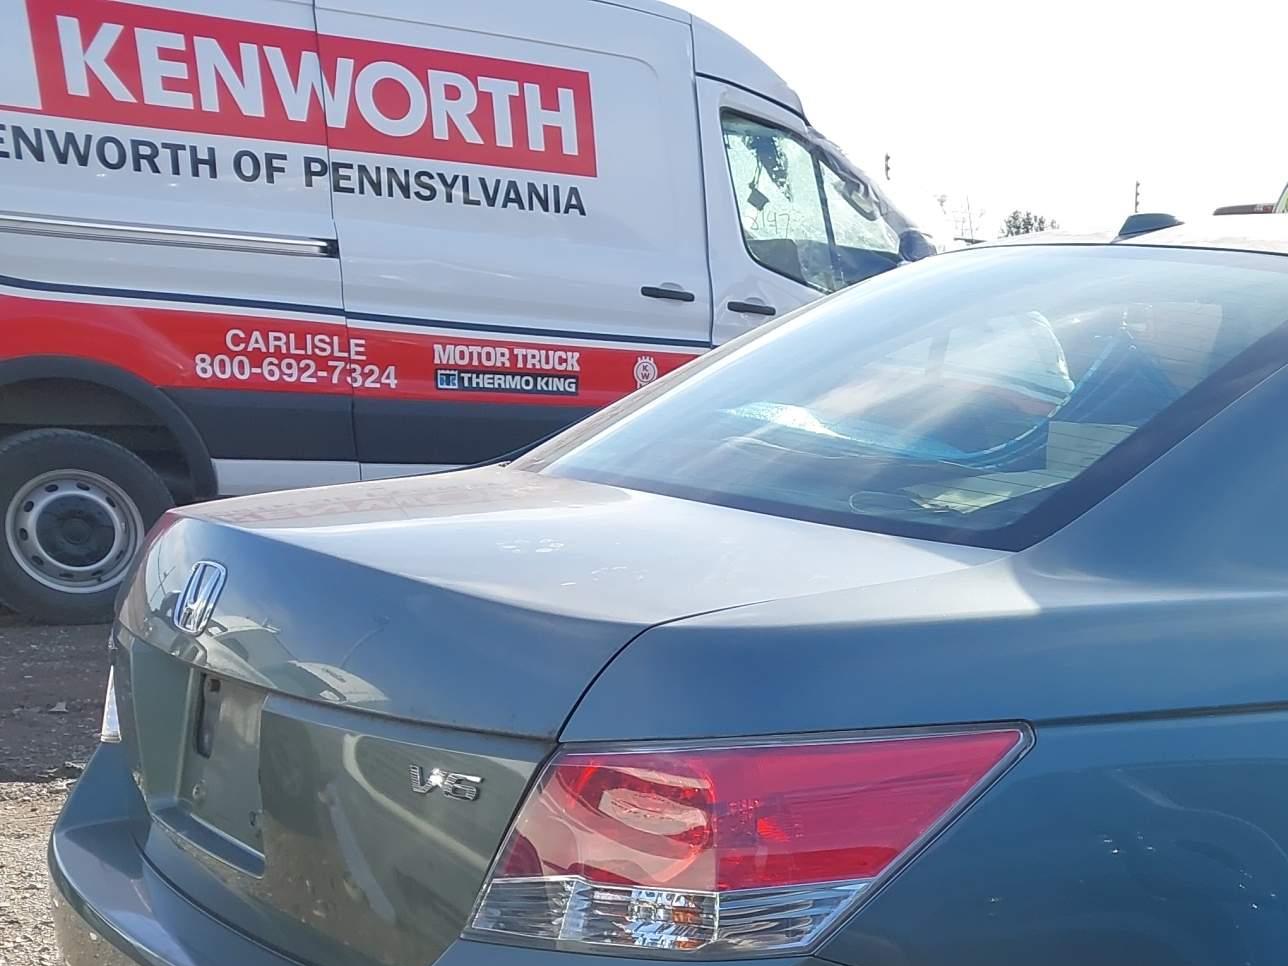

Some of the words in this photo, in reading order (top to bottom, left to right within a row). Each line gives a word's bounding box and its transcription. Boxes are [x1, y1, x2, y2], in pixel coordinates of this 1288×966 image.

[56, 14, 579, 156] KENWORTH
[233, 149, 288, 184] OF
[303, 156, 587, 216] PENNSYLVANIA
[225, 328, 367, 360] CARLISLE
[433, 343, 510, 367] MOTOR
[513, 348, 580, 371] TRUCK
[195, 353, 398, 388] 800-692-7324
[460, 373, 534, 390] THERMO
[536, 376, 577, 392] KING
[408, 763, 482, 801] V6
